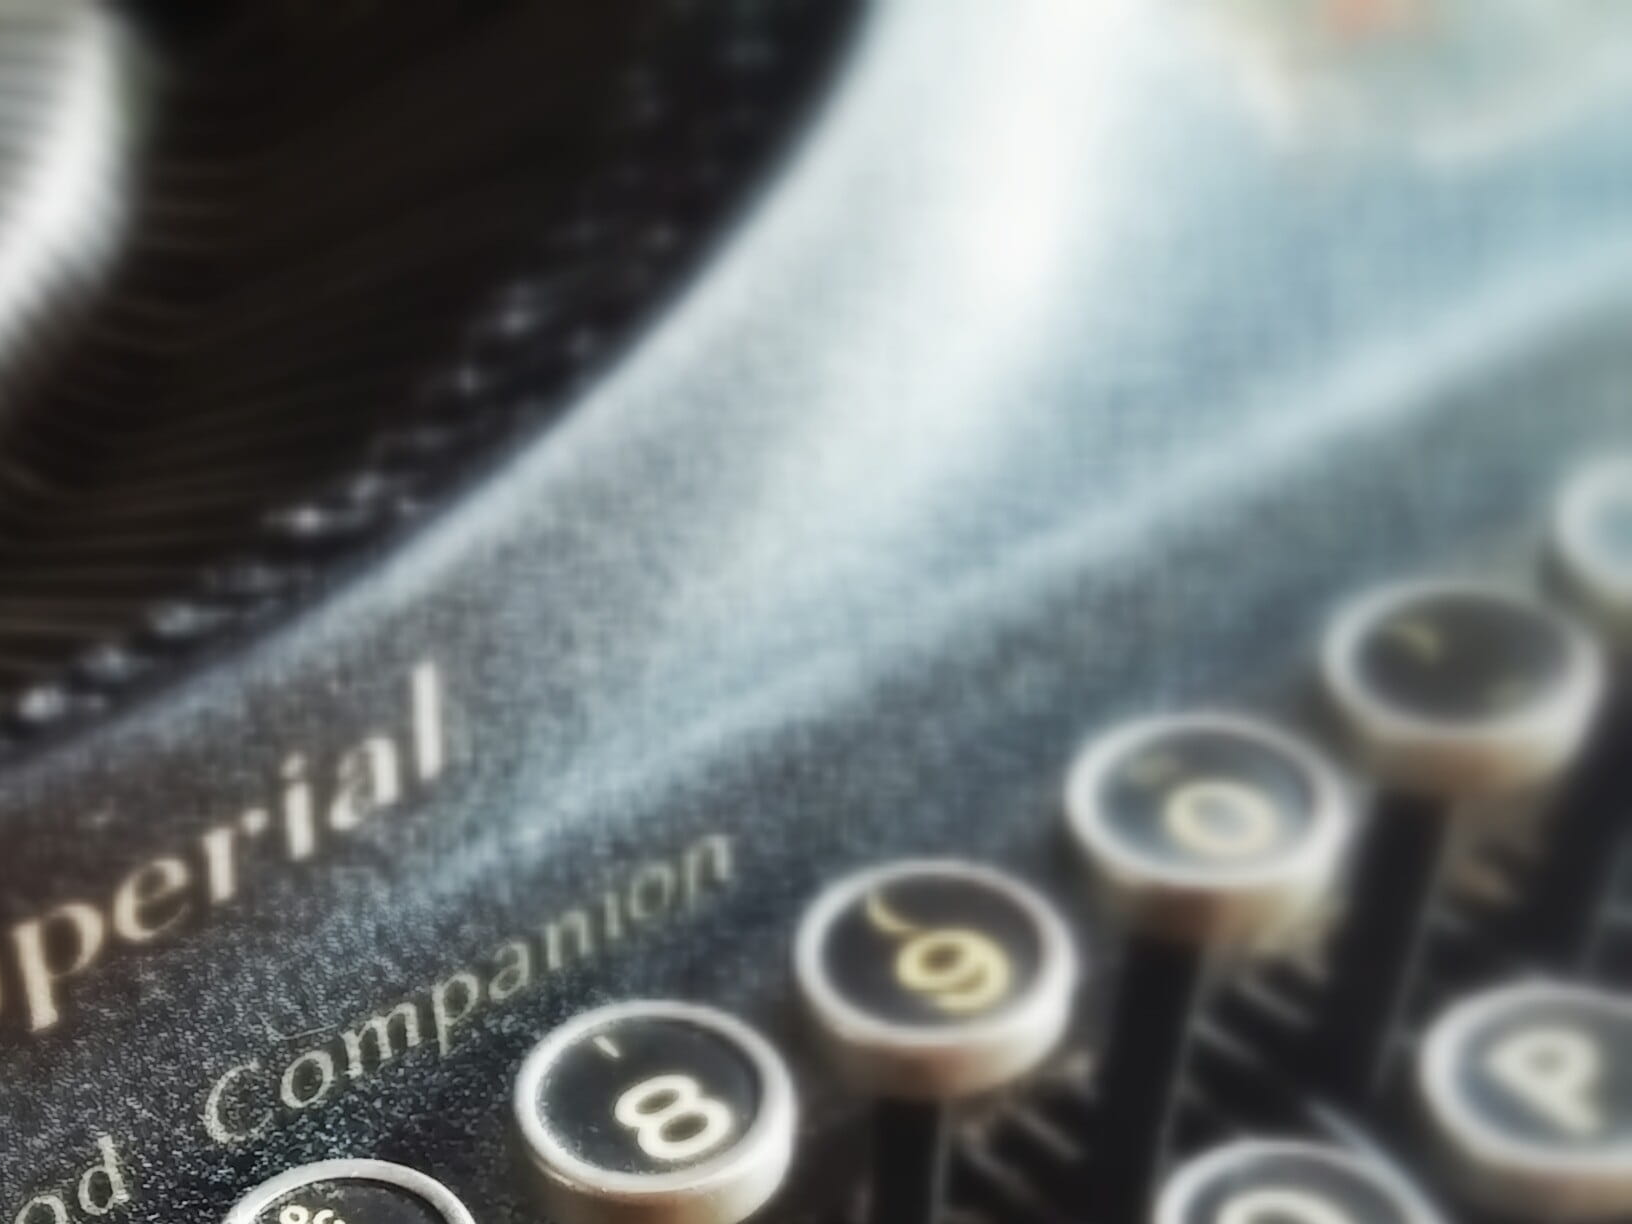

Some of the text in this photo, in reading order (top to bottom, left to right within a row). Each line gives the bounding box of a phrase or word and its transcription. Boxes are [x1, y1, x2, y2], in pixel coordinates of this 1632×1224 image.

[205, 831, 734, 1146] Companion
[897, 930, 1010, 1011] 9
[616, 1075, 728, 1157] 8
[1486, 1030, 1598, 1131] P
